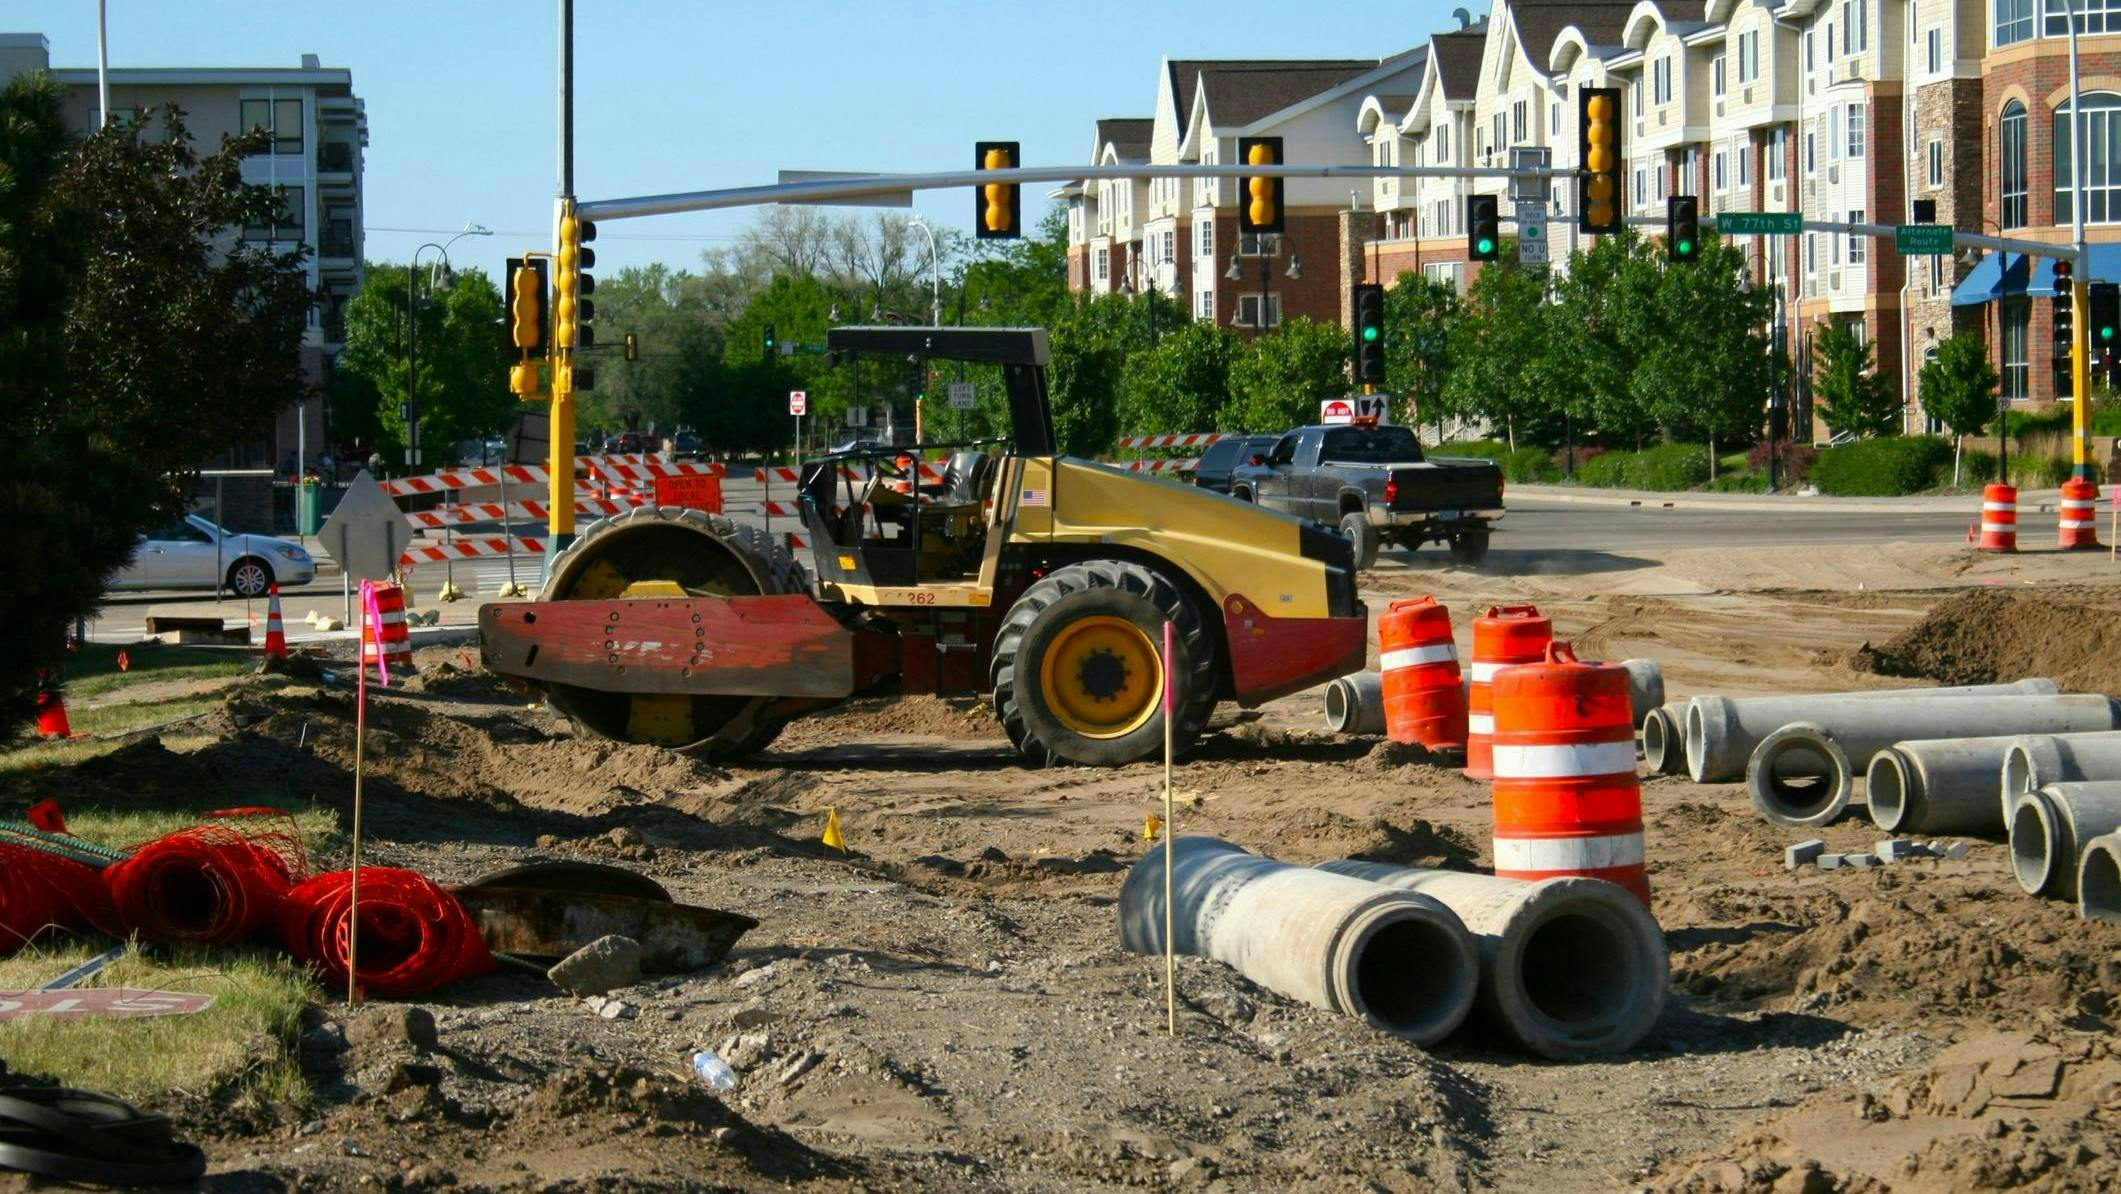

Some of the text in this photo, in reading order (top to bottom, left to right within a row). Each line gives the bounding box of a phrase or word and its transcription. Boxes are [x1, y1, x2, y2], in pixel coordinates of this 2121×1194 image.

[1722, 217, 1799, 229] W 77th St
[1522, 244, 1545, 254] NO U
